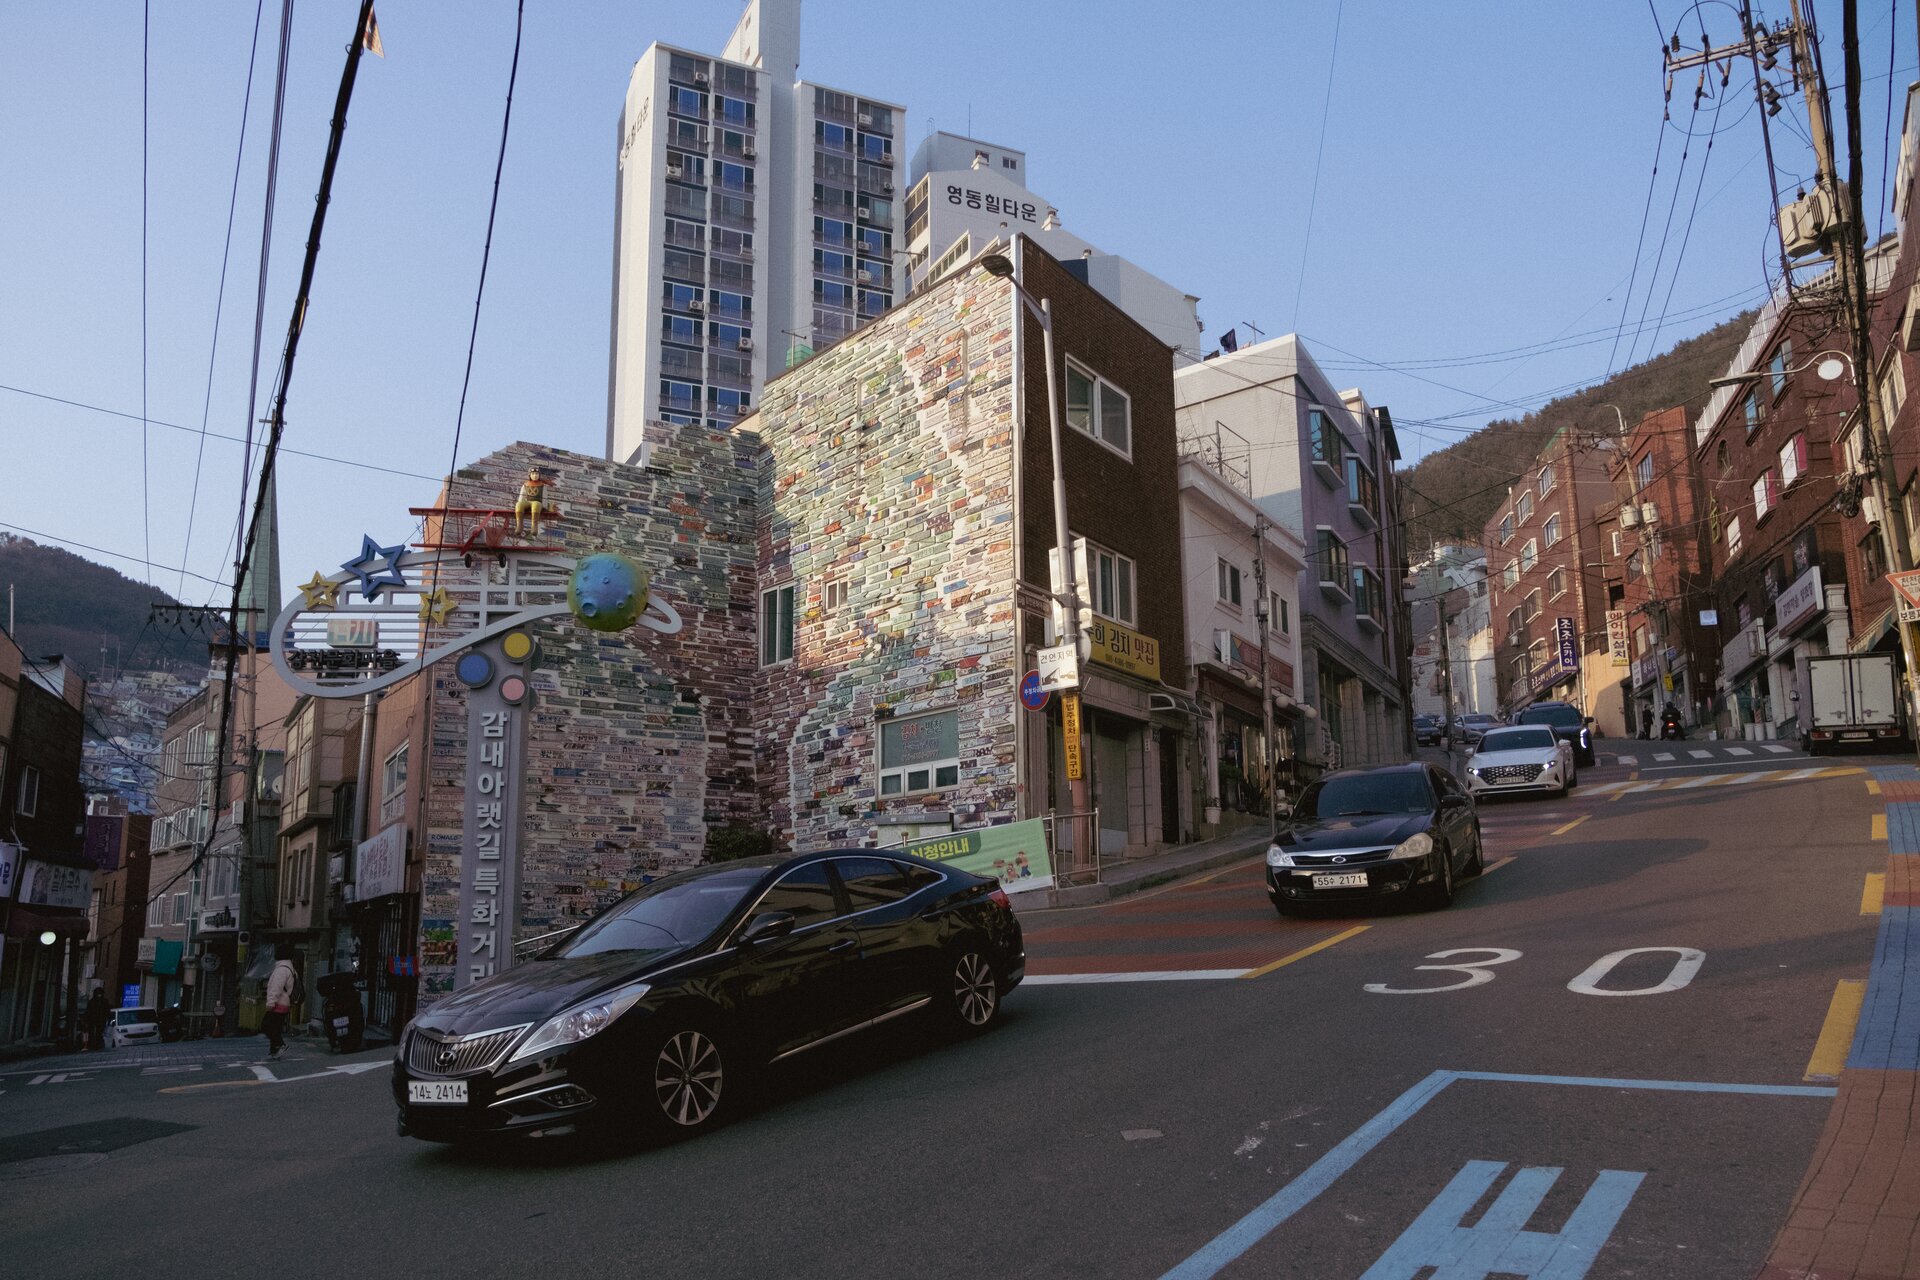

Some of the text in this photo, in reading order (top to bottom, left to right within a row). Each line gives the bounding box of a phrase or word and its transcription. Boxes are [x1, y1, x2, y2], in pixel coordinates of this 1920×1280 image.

[947, 185, 1037, 223] 영동힐타운
[1110, 628, 1131, 656] 김치
[1134, 637, 1155, 666] 맛집
[1559, 619, 1575, 665] 조조스카이
[1610, 612, 1626, 658] 에어컨설치
[1040, 649, 1074, 665] 견인지역
[1024, 685, 1045, 696] 주정차금
[470, 711, 508, 983] 감내아랫길 특화거리
[1317, 875, 1363, 886] 55수 2171
[1362, 946, 1707, 997] 30
[415, 1084, 463, 1100] 14노 2414
